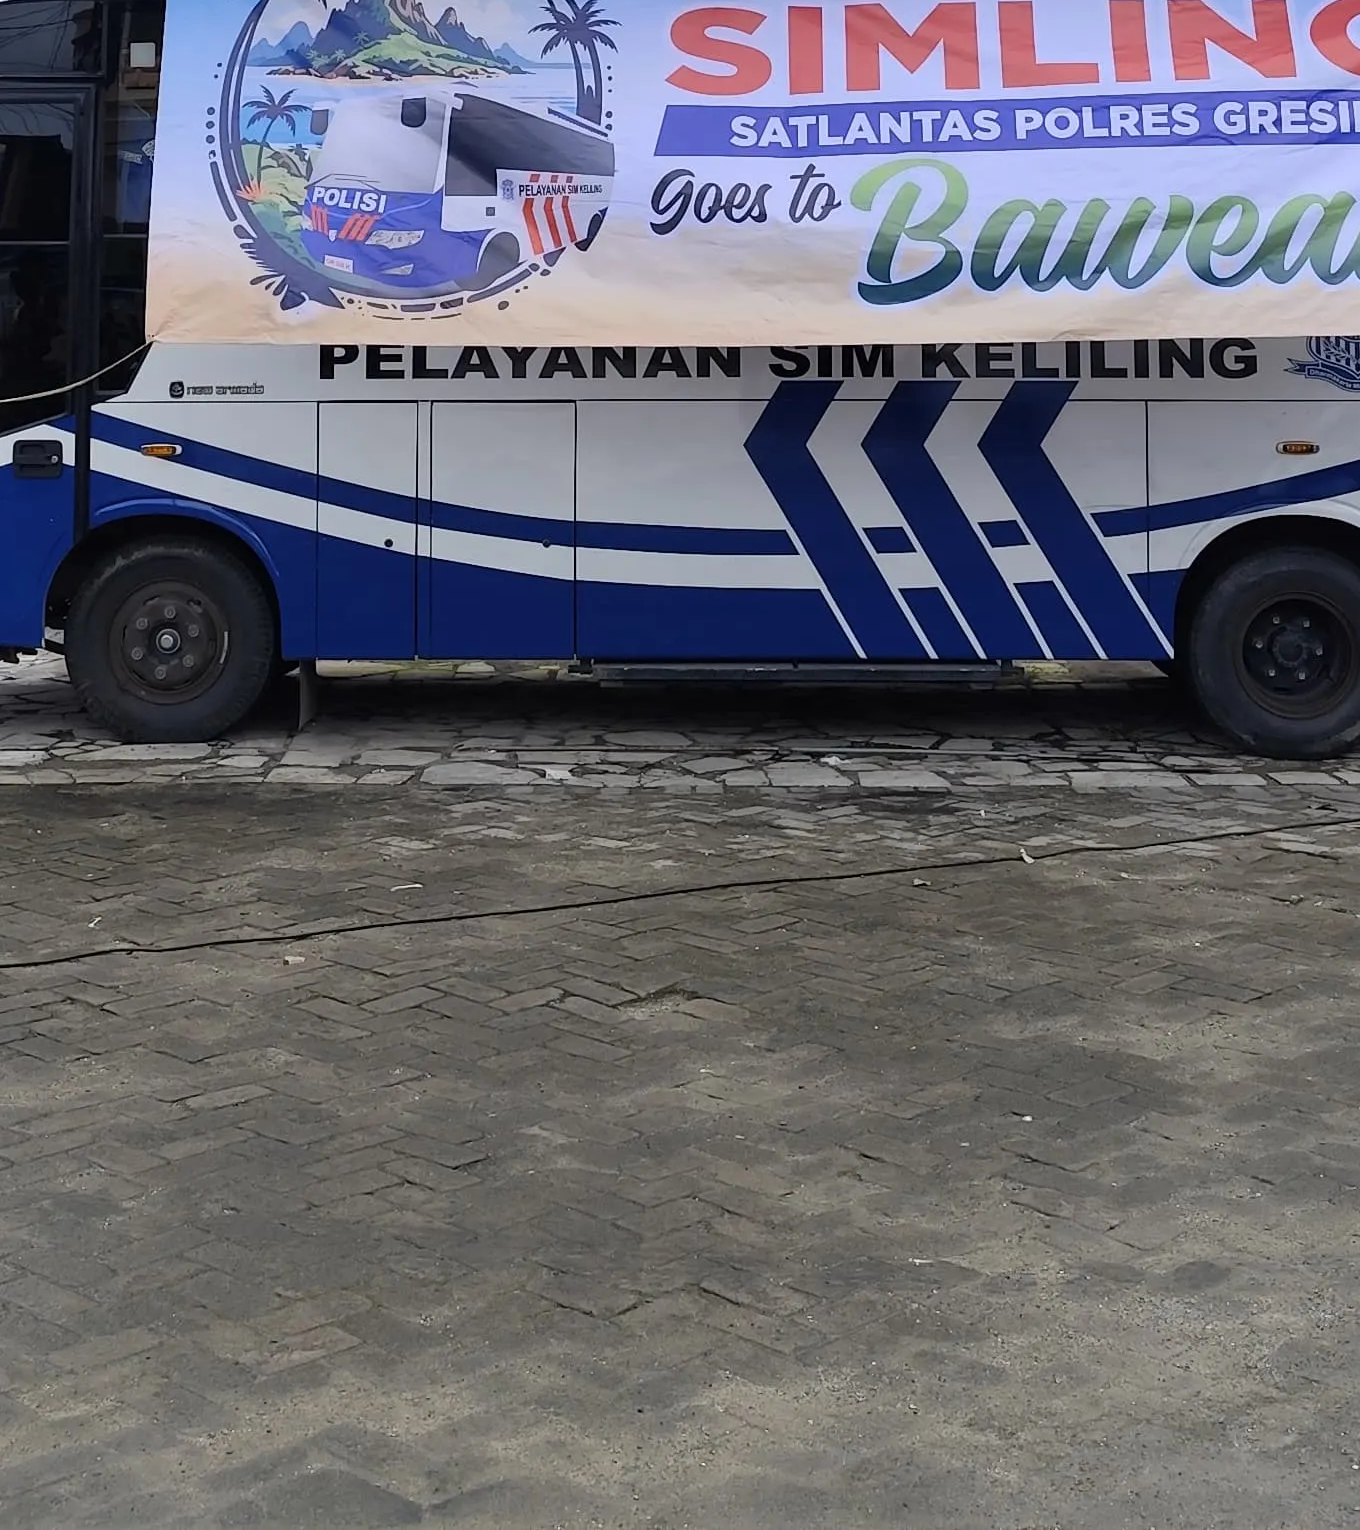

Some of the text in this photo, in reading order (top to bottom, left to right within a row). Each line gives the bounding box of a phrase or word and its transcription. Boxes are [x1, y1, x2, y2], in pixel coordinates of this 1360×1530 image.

[730, 108, 1001, 150] SATLANTAS
[1015, 102, 1200, 141] POLRES
[311, 186, 387, 214] POLISI
[518, 183, 566, 196] PELAYANAN
[649, 168, 773, 236] goes
[788, 164, 842, 223] to
[320, 337, 1259, 380] PELAYANAN SIM KELILING
